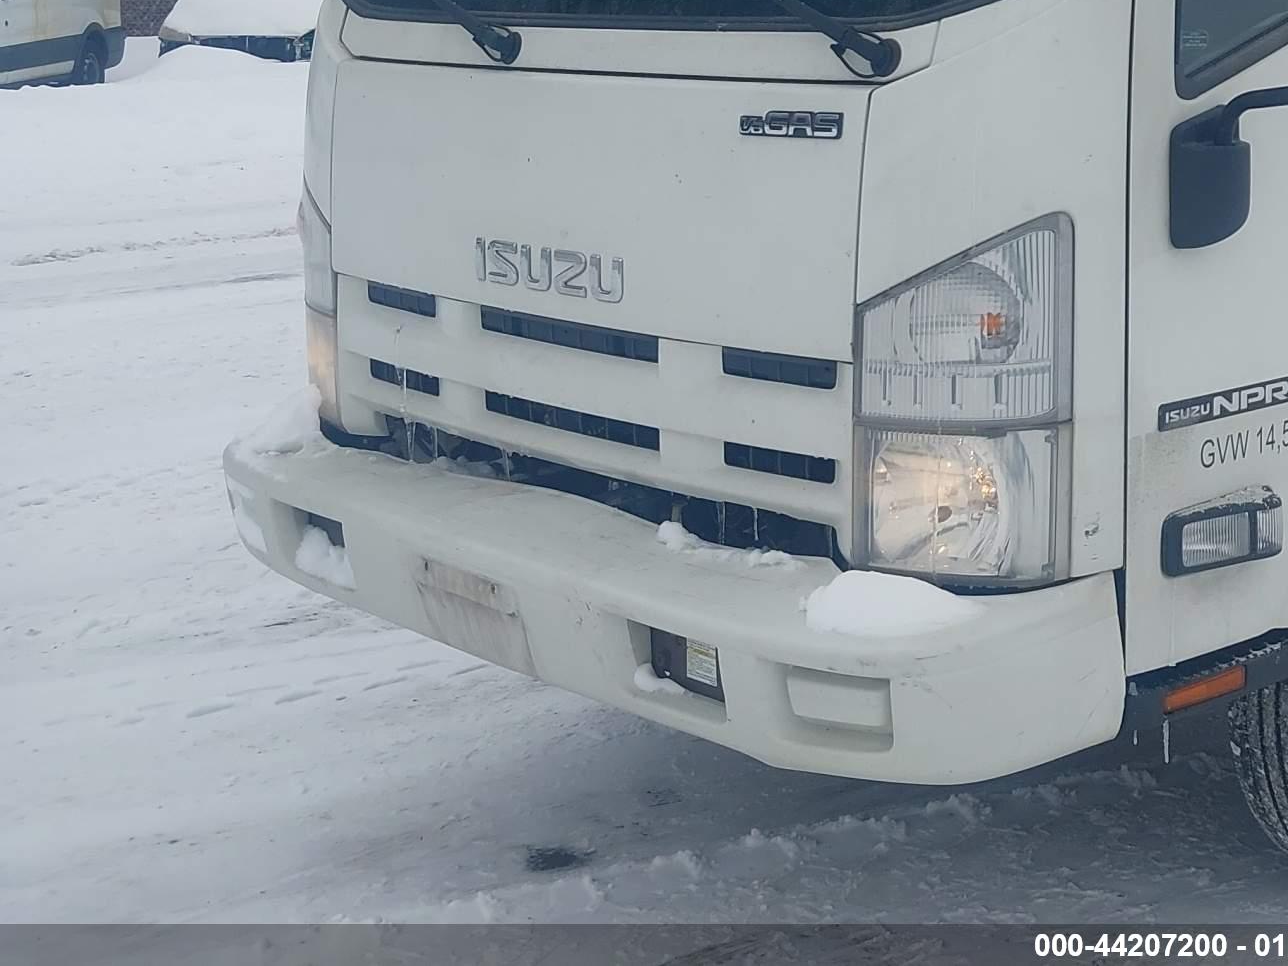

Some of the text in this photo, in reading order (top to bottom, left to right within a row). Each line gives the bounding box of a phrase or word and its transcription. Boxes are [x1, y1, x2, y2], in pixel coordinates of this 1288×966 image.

[765, 111, 843, 139] GAS
[475, 236, 624, 303] ISUZU
[1165, 401, 1211, 424] ISUZU
[1213, 380, 1288, 417] NPR
[1200, 430, 1250, 468] GVW
